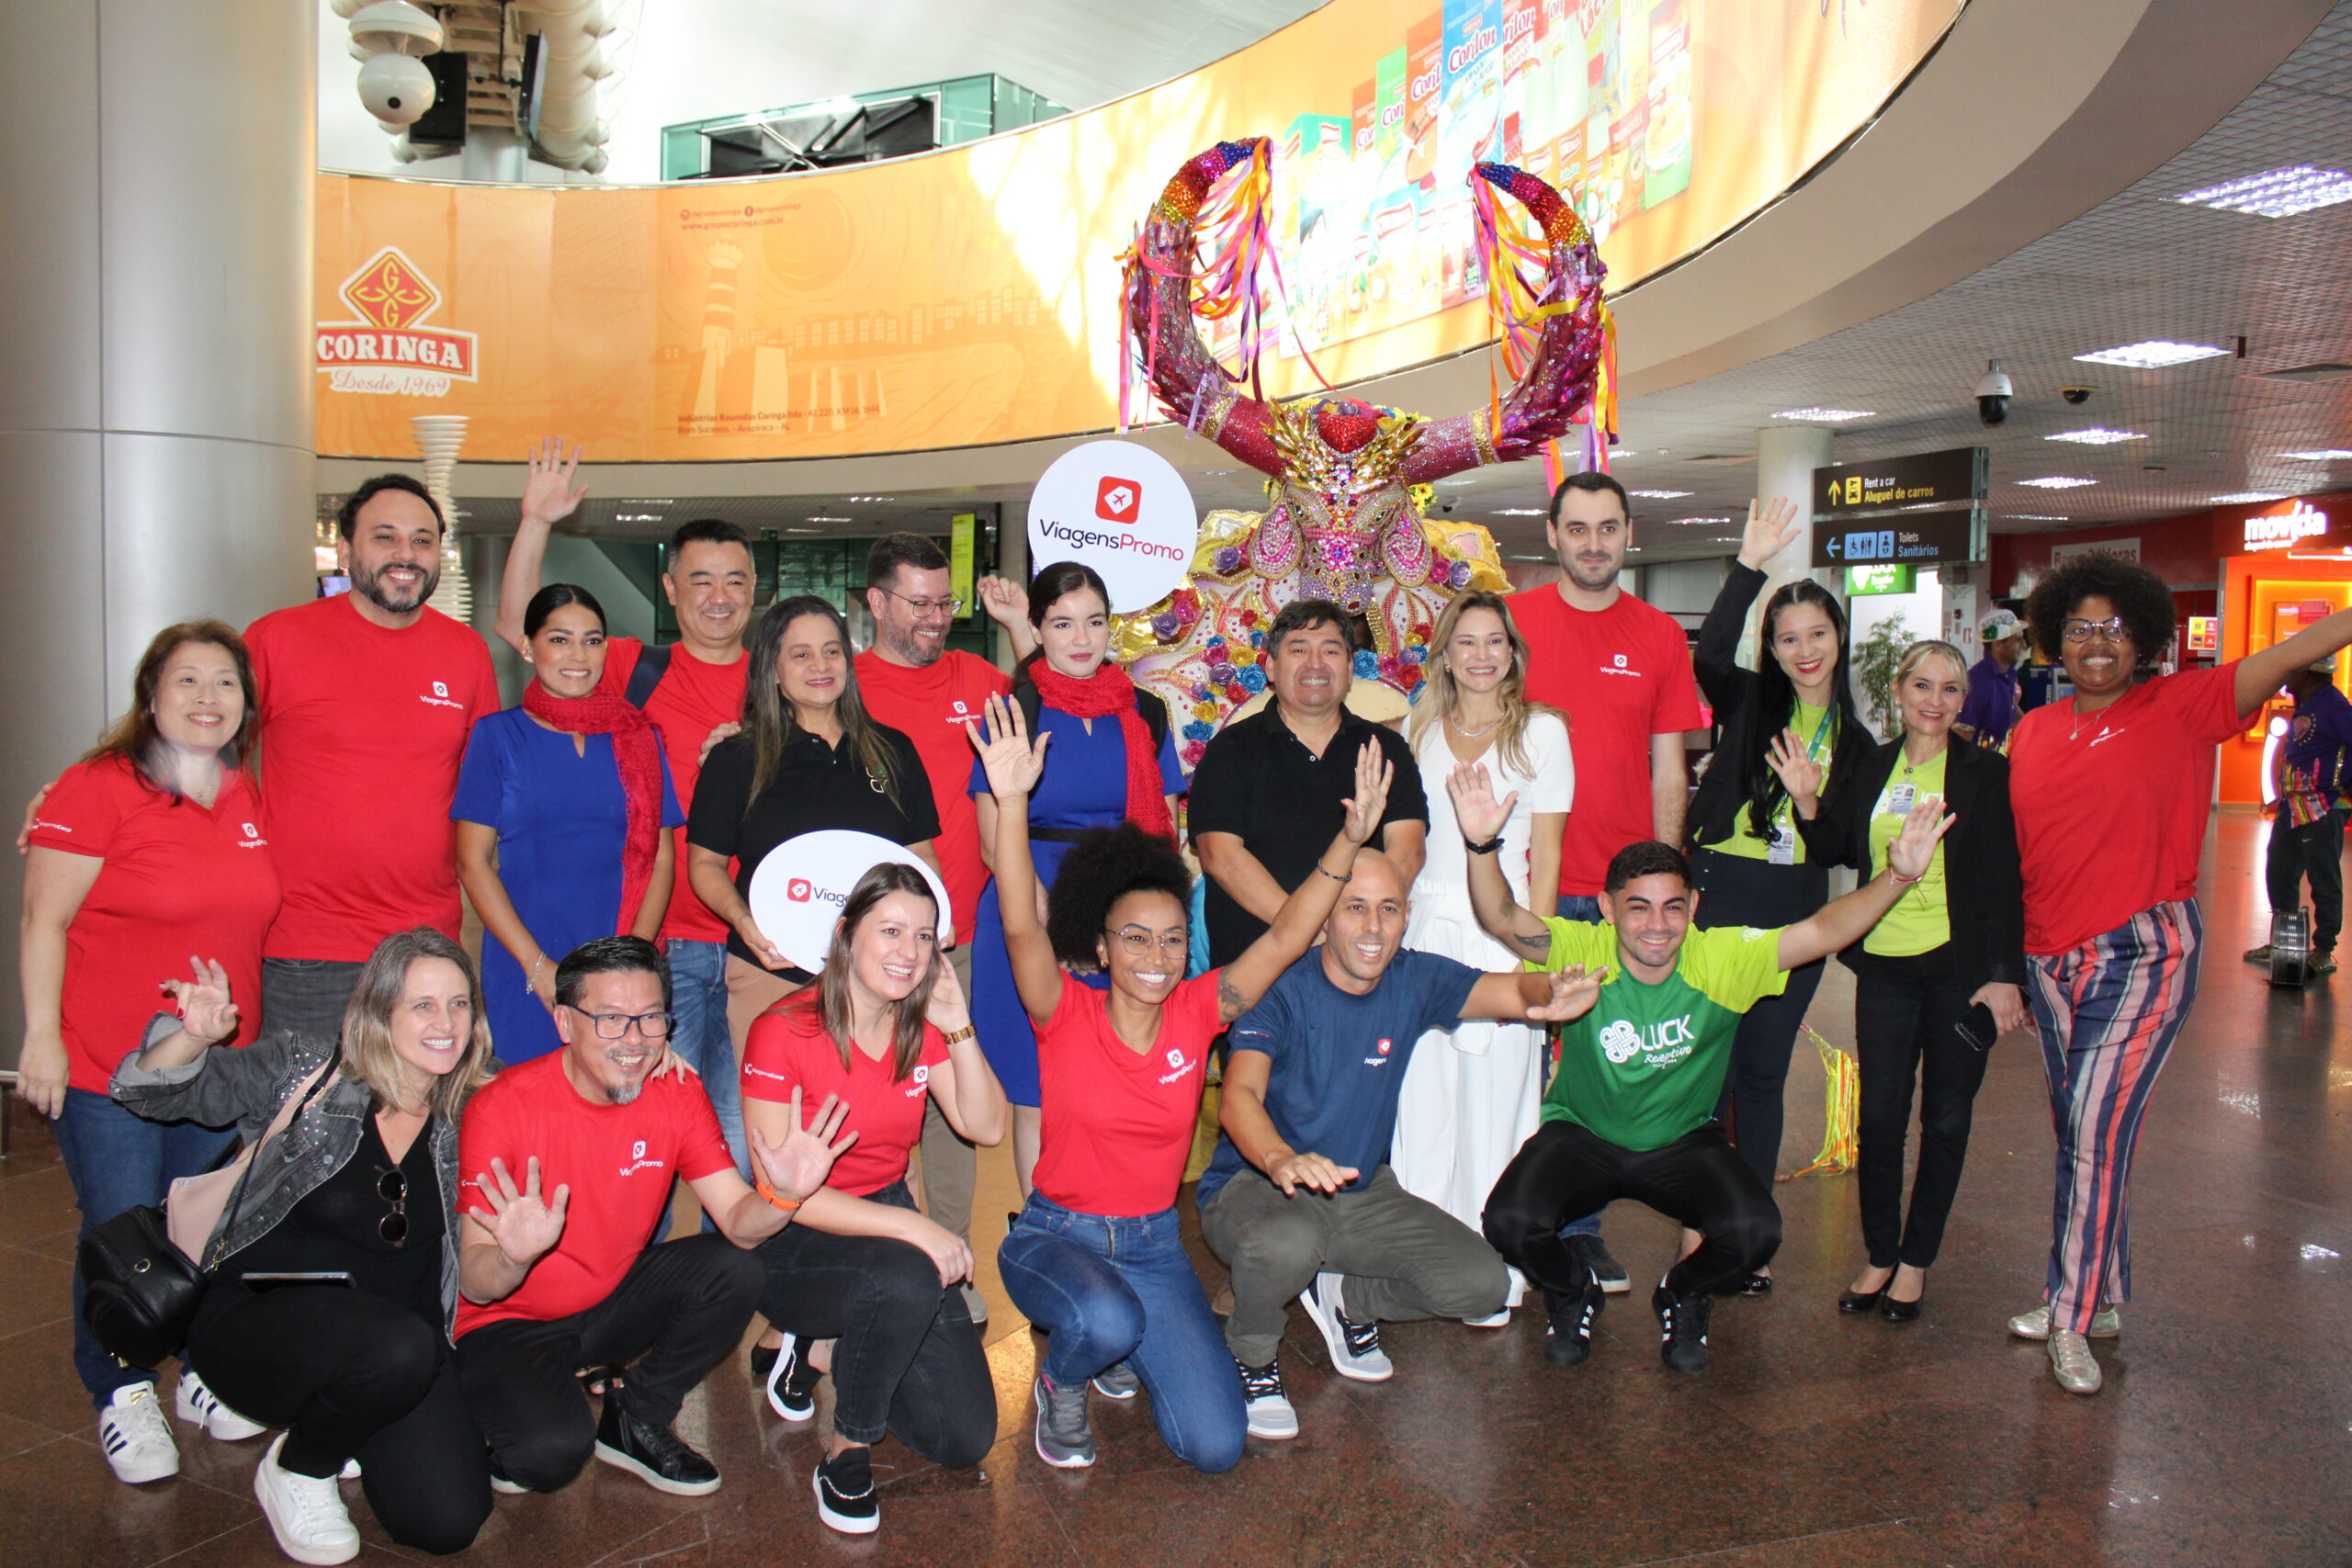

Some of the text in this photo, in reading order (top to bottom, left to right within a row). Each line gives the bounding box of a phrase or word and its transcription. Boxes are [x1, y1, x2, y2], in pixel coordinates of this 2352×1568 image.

[1503, 8, 1534, 42] rilon
[1449, 27, 1495, 72] Corilon
[1413, 64, 1441, 98] Coril
[1383, 99, 1404, 126] Cori
[317, 334, 463, 369] CORINGA
[334, 370, 447, 393] Desde 1969
[757, 412, 786, 421] Coringa
[1865, 478, 1878, 489] Rent
[1885, 476, 1895, 486] car
[1865, 487, 1934, 503] Aluguel de carros
[2245, 501, 2327, 543] movida
[1040, 519, 1184, 561] ViagensPromo
[1898, 532, 1918, 542] Toilets
[1898, 545, 1939, 558] Sanitários
[1600, 667, 1641, 676] ViagensPromo
[420, 695, 463, 709] ViagensPromo
[1641, 1014, 1694, 1051] LUCK
